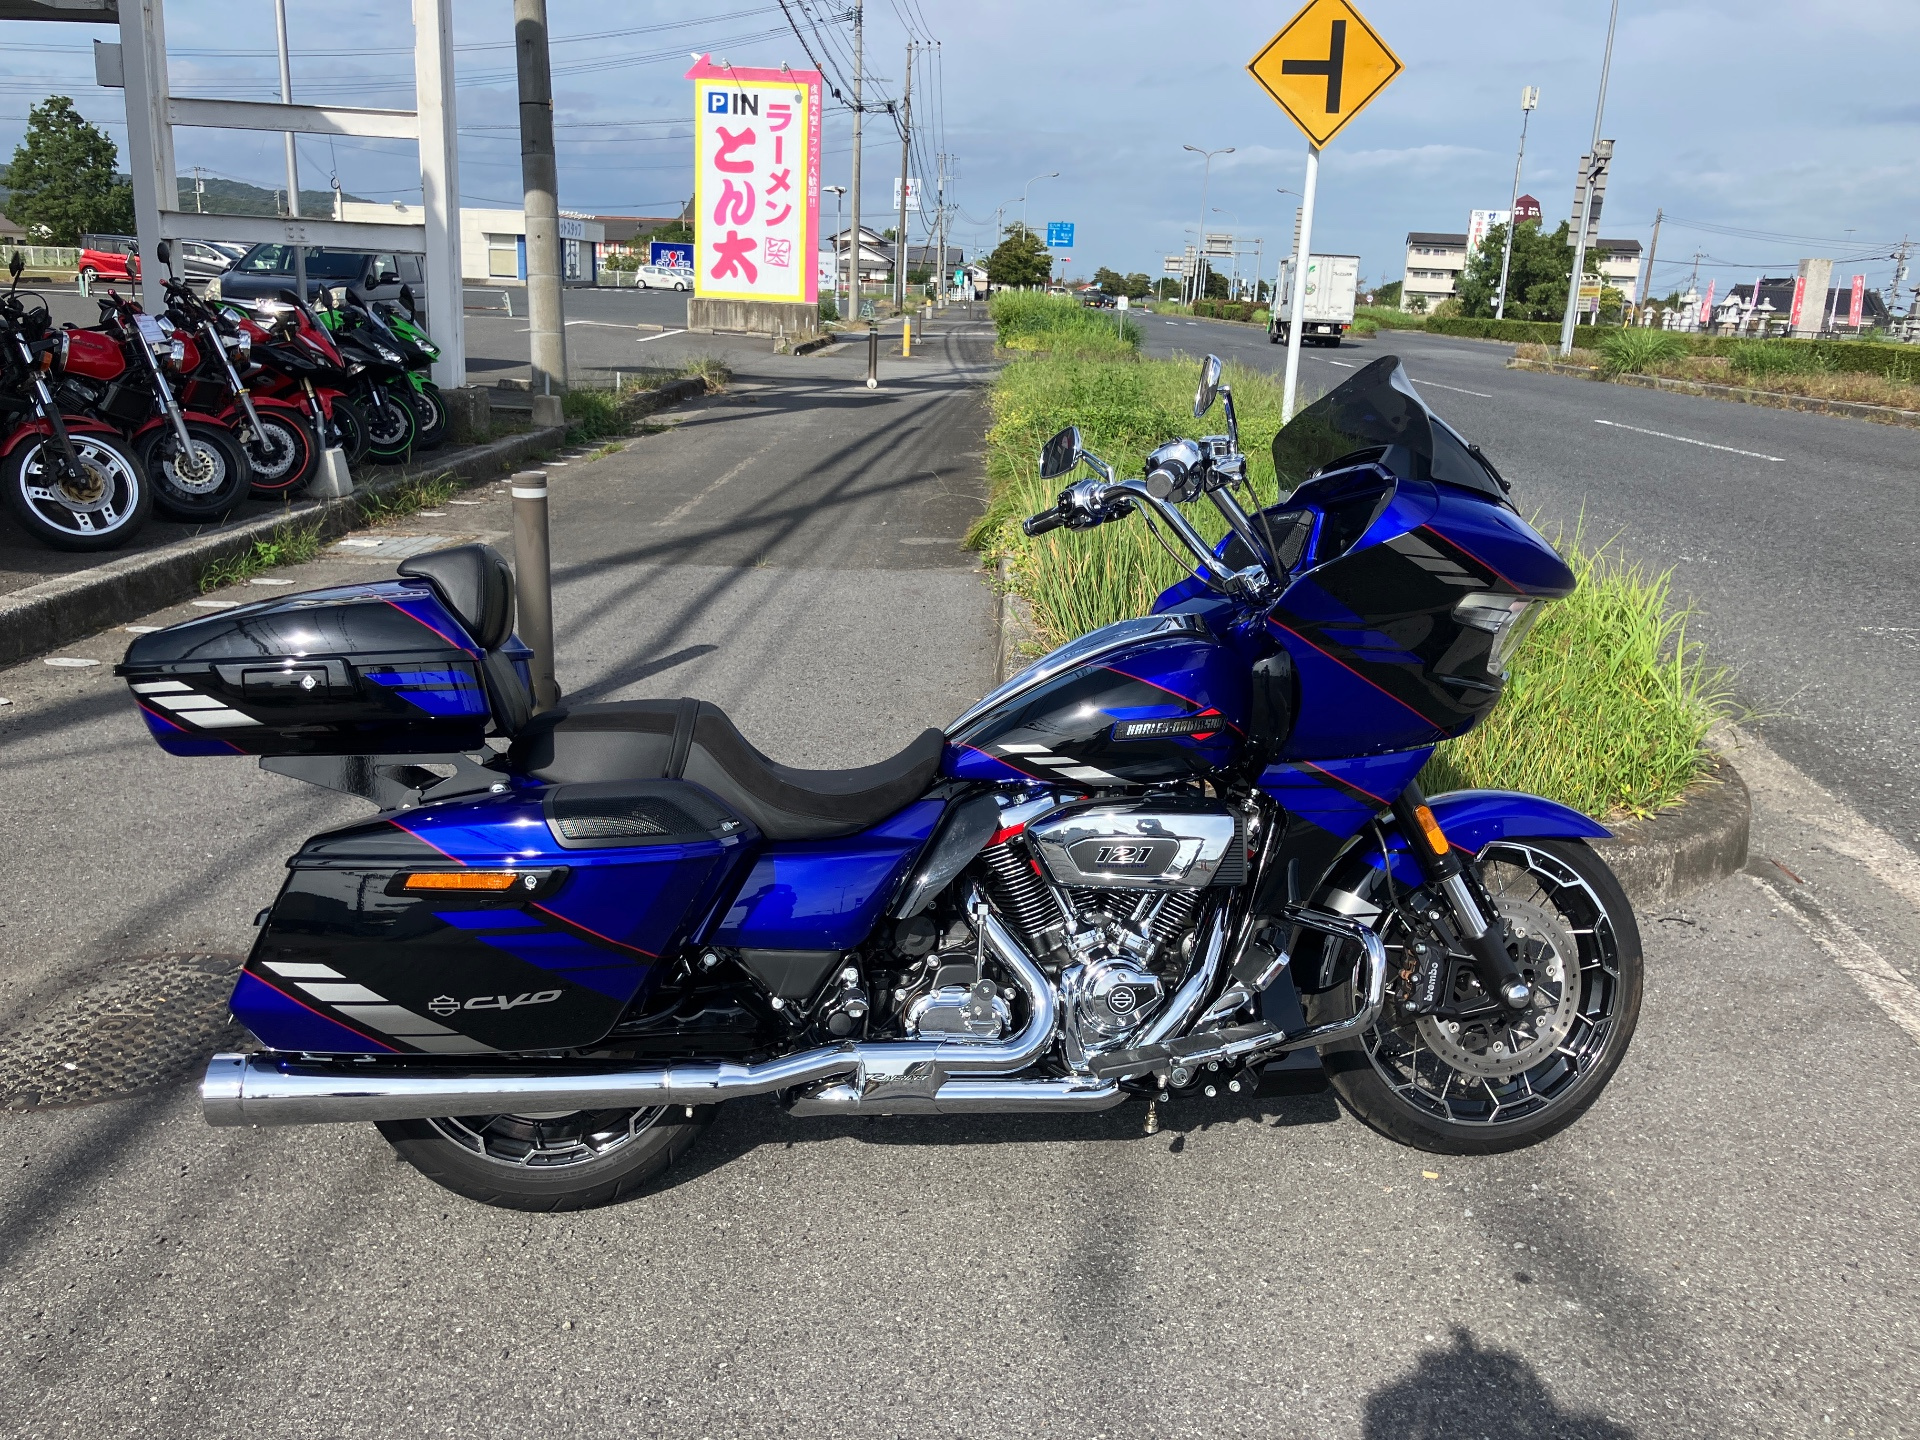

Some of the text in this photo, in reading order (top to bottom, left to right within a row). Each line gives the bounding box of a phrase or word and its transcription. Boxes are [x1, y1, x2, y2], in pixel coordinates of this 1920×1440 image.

[733, 93, 758, 116] IN
[765, 104, 792, 227] ラーメン
[710, 126, 758, 284] とん太
[660, 250, 685, 262] HOT
[1095, 846, 1154, 864] 121
[1423, 962, 1439, 1002] brembo
[463, 989, 563, 1010] CVO
